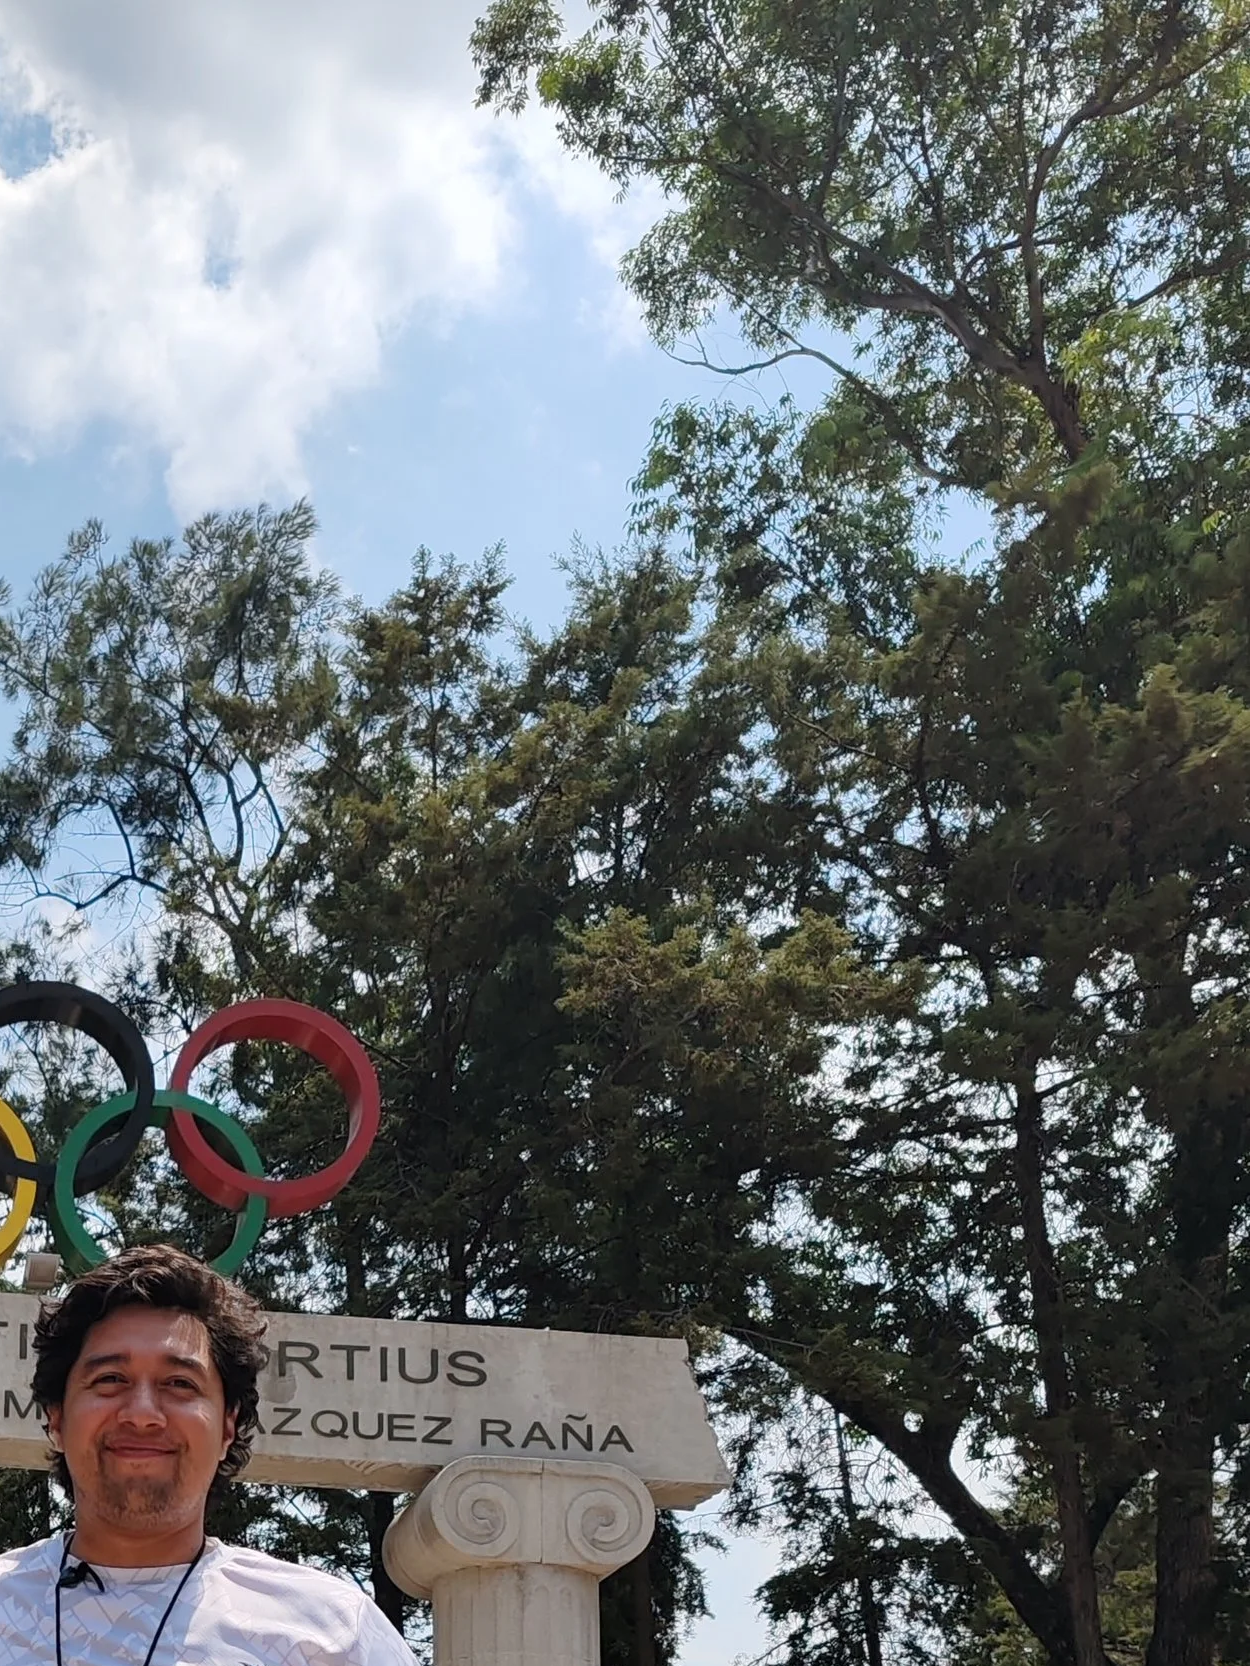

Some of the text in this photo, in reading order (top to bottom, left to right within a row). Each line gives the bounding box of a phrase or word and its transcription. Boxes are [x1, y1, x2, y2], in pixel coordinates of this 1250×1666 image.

[258, 1340, 488, 1387] RTIUS
[254, 1407, 454, 1445] ZQUEZ
[480, 1413, 635, 1453] RAÑA
